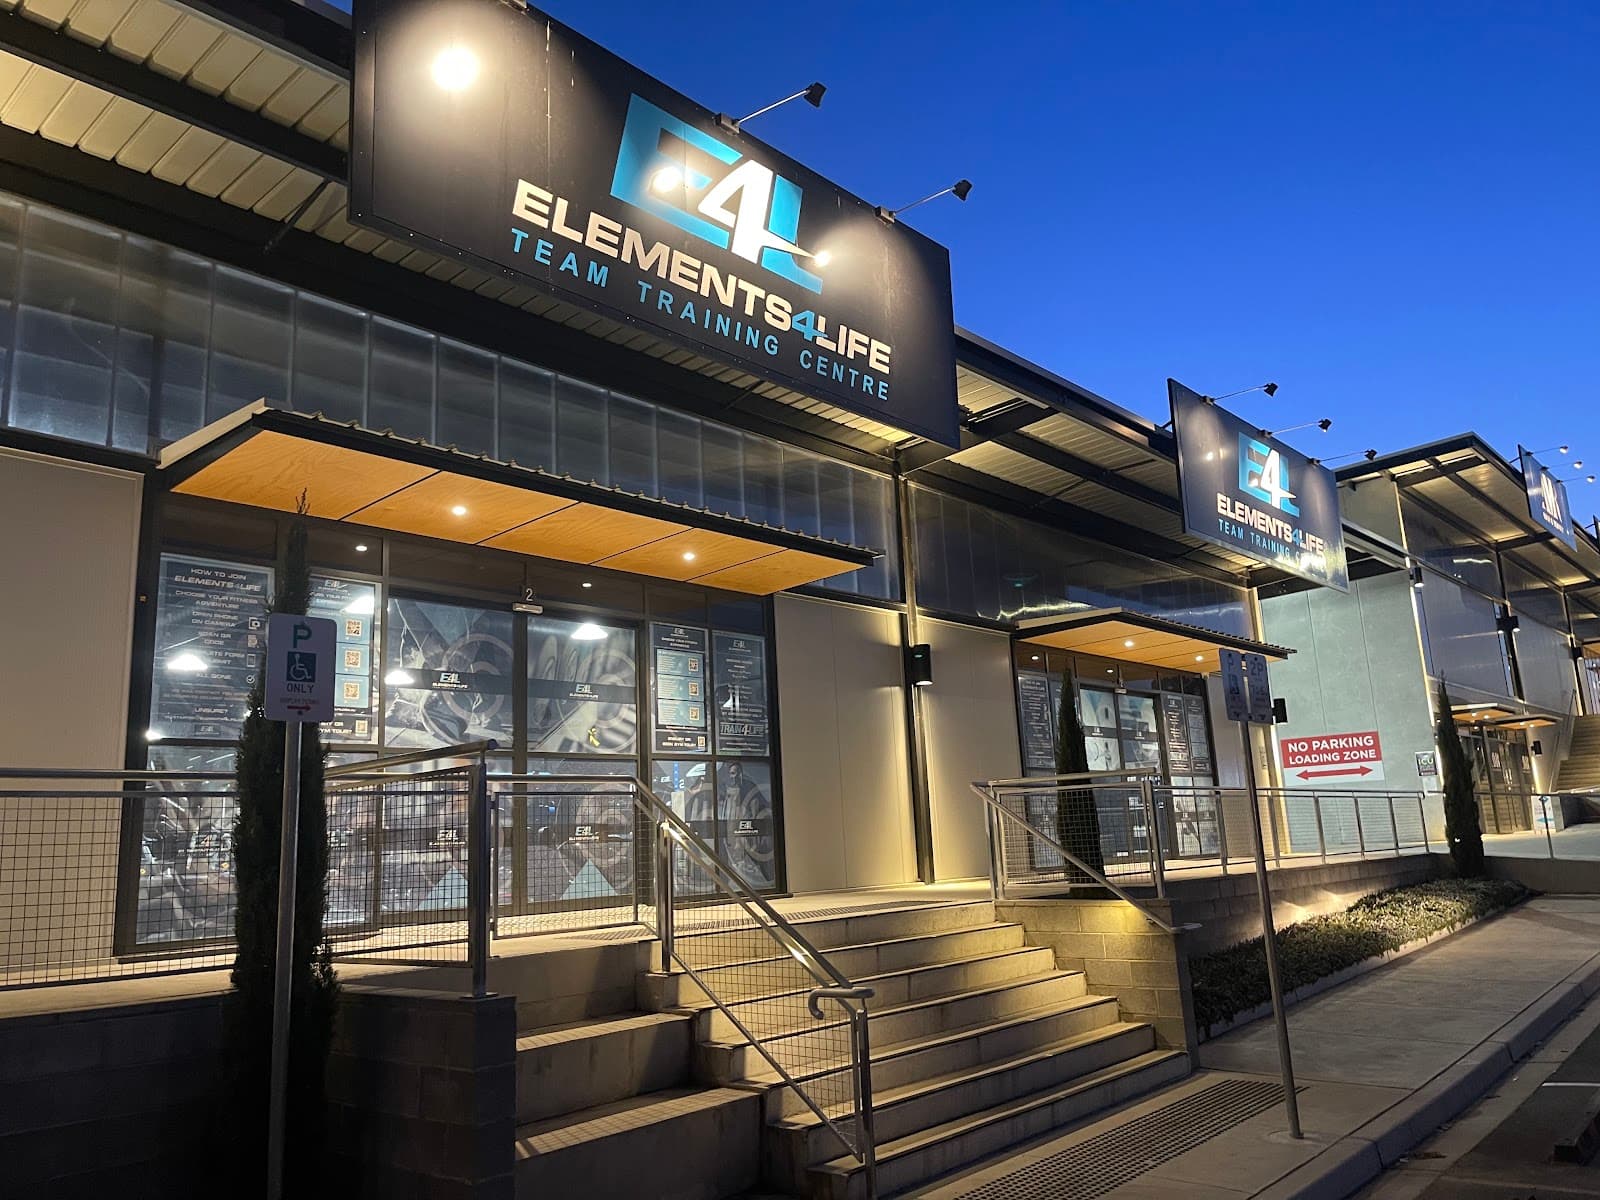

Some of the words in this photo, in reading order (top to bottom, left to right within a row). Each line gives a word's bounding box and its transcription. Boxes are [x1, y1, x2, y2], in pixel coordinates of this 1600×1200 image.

[609, 93, 824, 295] E4L
[512, 179, 892, 375] ELEMENTS4LIFE
[511, 228, 609, 288] TEAM
[637, 280, 779, 356] TRAINING
[800, 350, 890, 401] CENTRE
[1238, 432, 1300, 518] E4L
[1216, 493, 1325, 553] ELEMENTS4LIFE
[1219, 519, 1244, 541] TEAM
[1250, 532, 1290, 557] TRAINING
[190, 568, 213, 576] HOW
[174, 575, 261, 592] ELEMENTS4LIFE
[176, 590, 206, 598] CHOOSE
[229, 596, 258, 604] FITNESS
[525, 587, 534, 601] 2
[195, 600, 240, 609] ADVENTURE
[293, 624, 312, 648] P
[1249, 660, 1264, 676] 2P
[440, 672, 461, 684] E4L
[286, 683, 315, 694] ONLY
[1287, 741, 1309, 753] NO
[1311, 735, 1374, 751] PARKING
[1288, 752, 1341, 766] LOADING
[1343, 748, 1377, 762] ZONE
[1418, 757, 1434, 766] ICU
